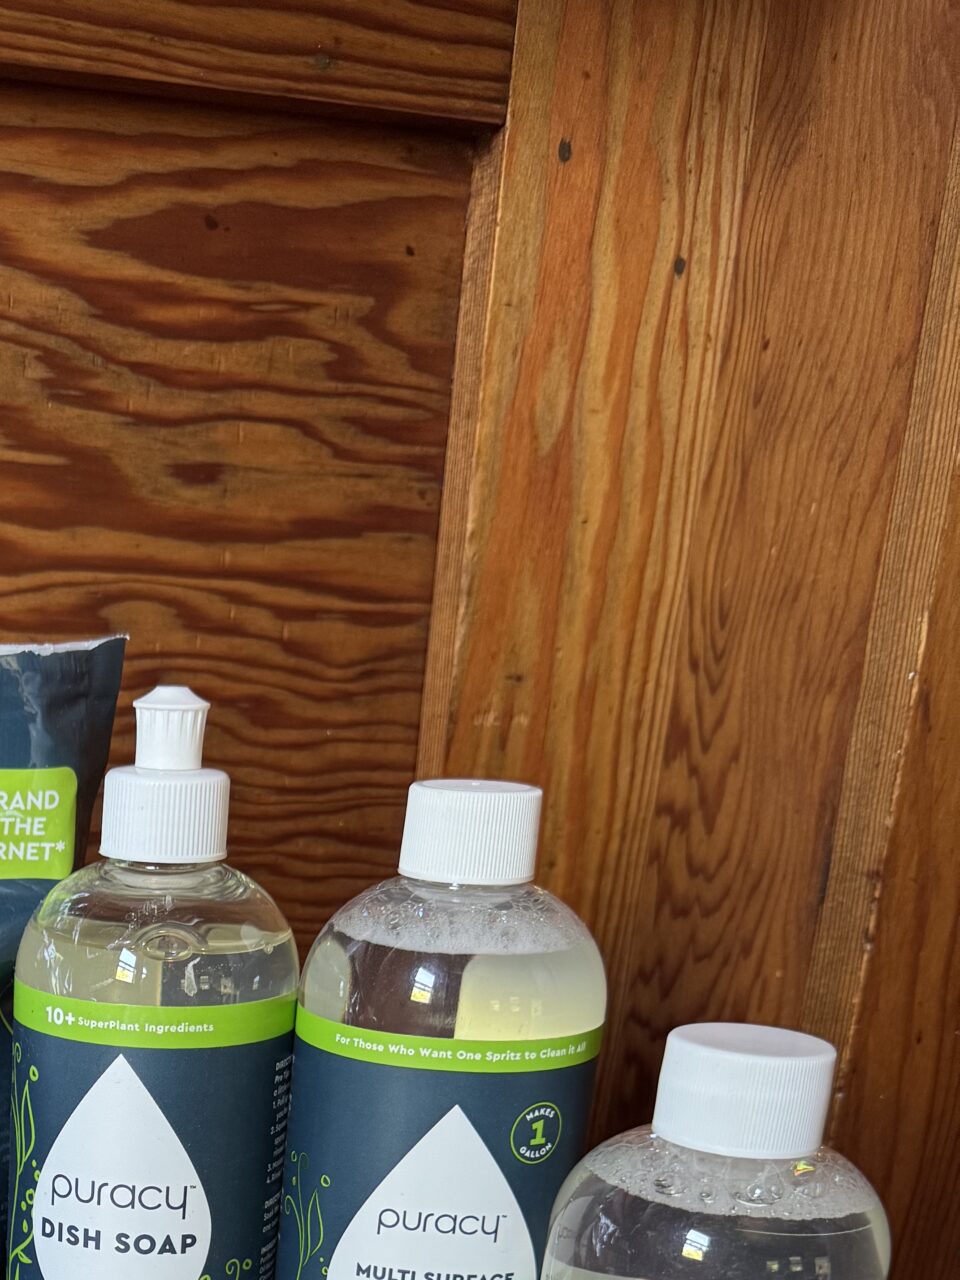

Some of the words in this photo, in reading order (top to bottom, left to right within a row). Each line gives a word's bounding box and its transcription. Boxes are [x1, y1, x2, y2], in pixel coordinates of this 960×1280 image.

[0, 816, 46, 836] THE
[45, 1006, 76, 1026] 10+
[78, 1016, 140, 1032] SuperPlant
[145, 1022, 214, 1034] Ingredients
[335, 1033, 351, 1046] For
[353, 1037, 384, 1052] Those
[388, 1044, 415, 1056] Who
[419, 1048, 452, 1060] Want
[457, 1050, 482, 1061] One
[486, 1051, 521, 1064] Spritz
[525, 1050, 537, 1060] to
[540, 1046, 566, 1058] Clean
[525, 1107, 555, 1121] MAKES
[529, 1119, 546, 1146] 1
[519, 1142, 552, 1158] GALLON
[41, 1216, 101, 1251] DISH
[114, 1233, 198, 1256] SOAP
